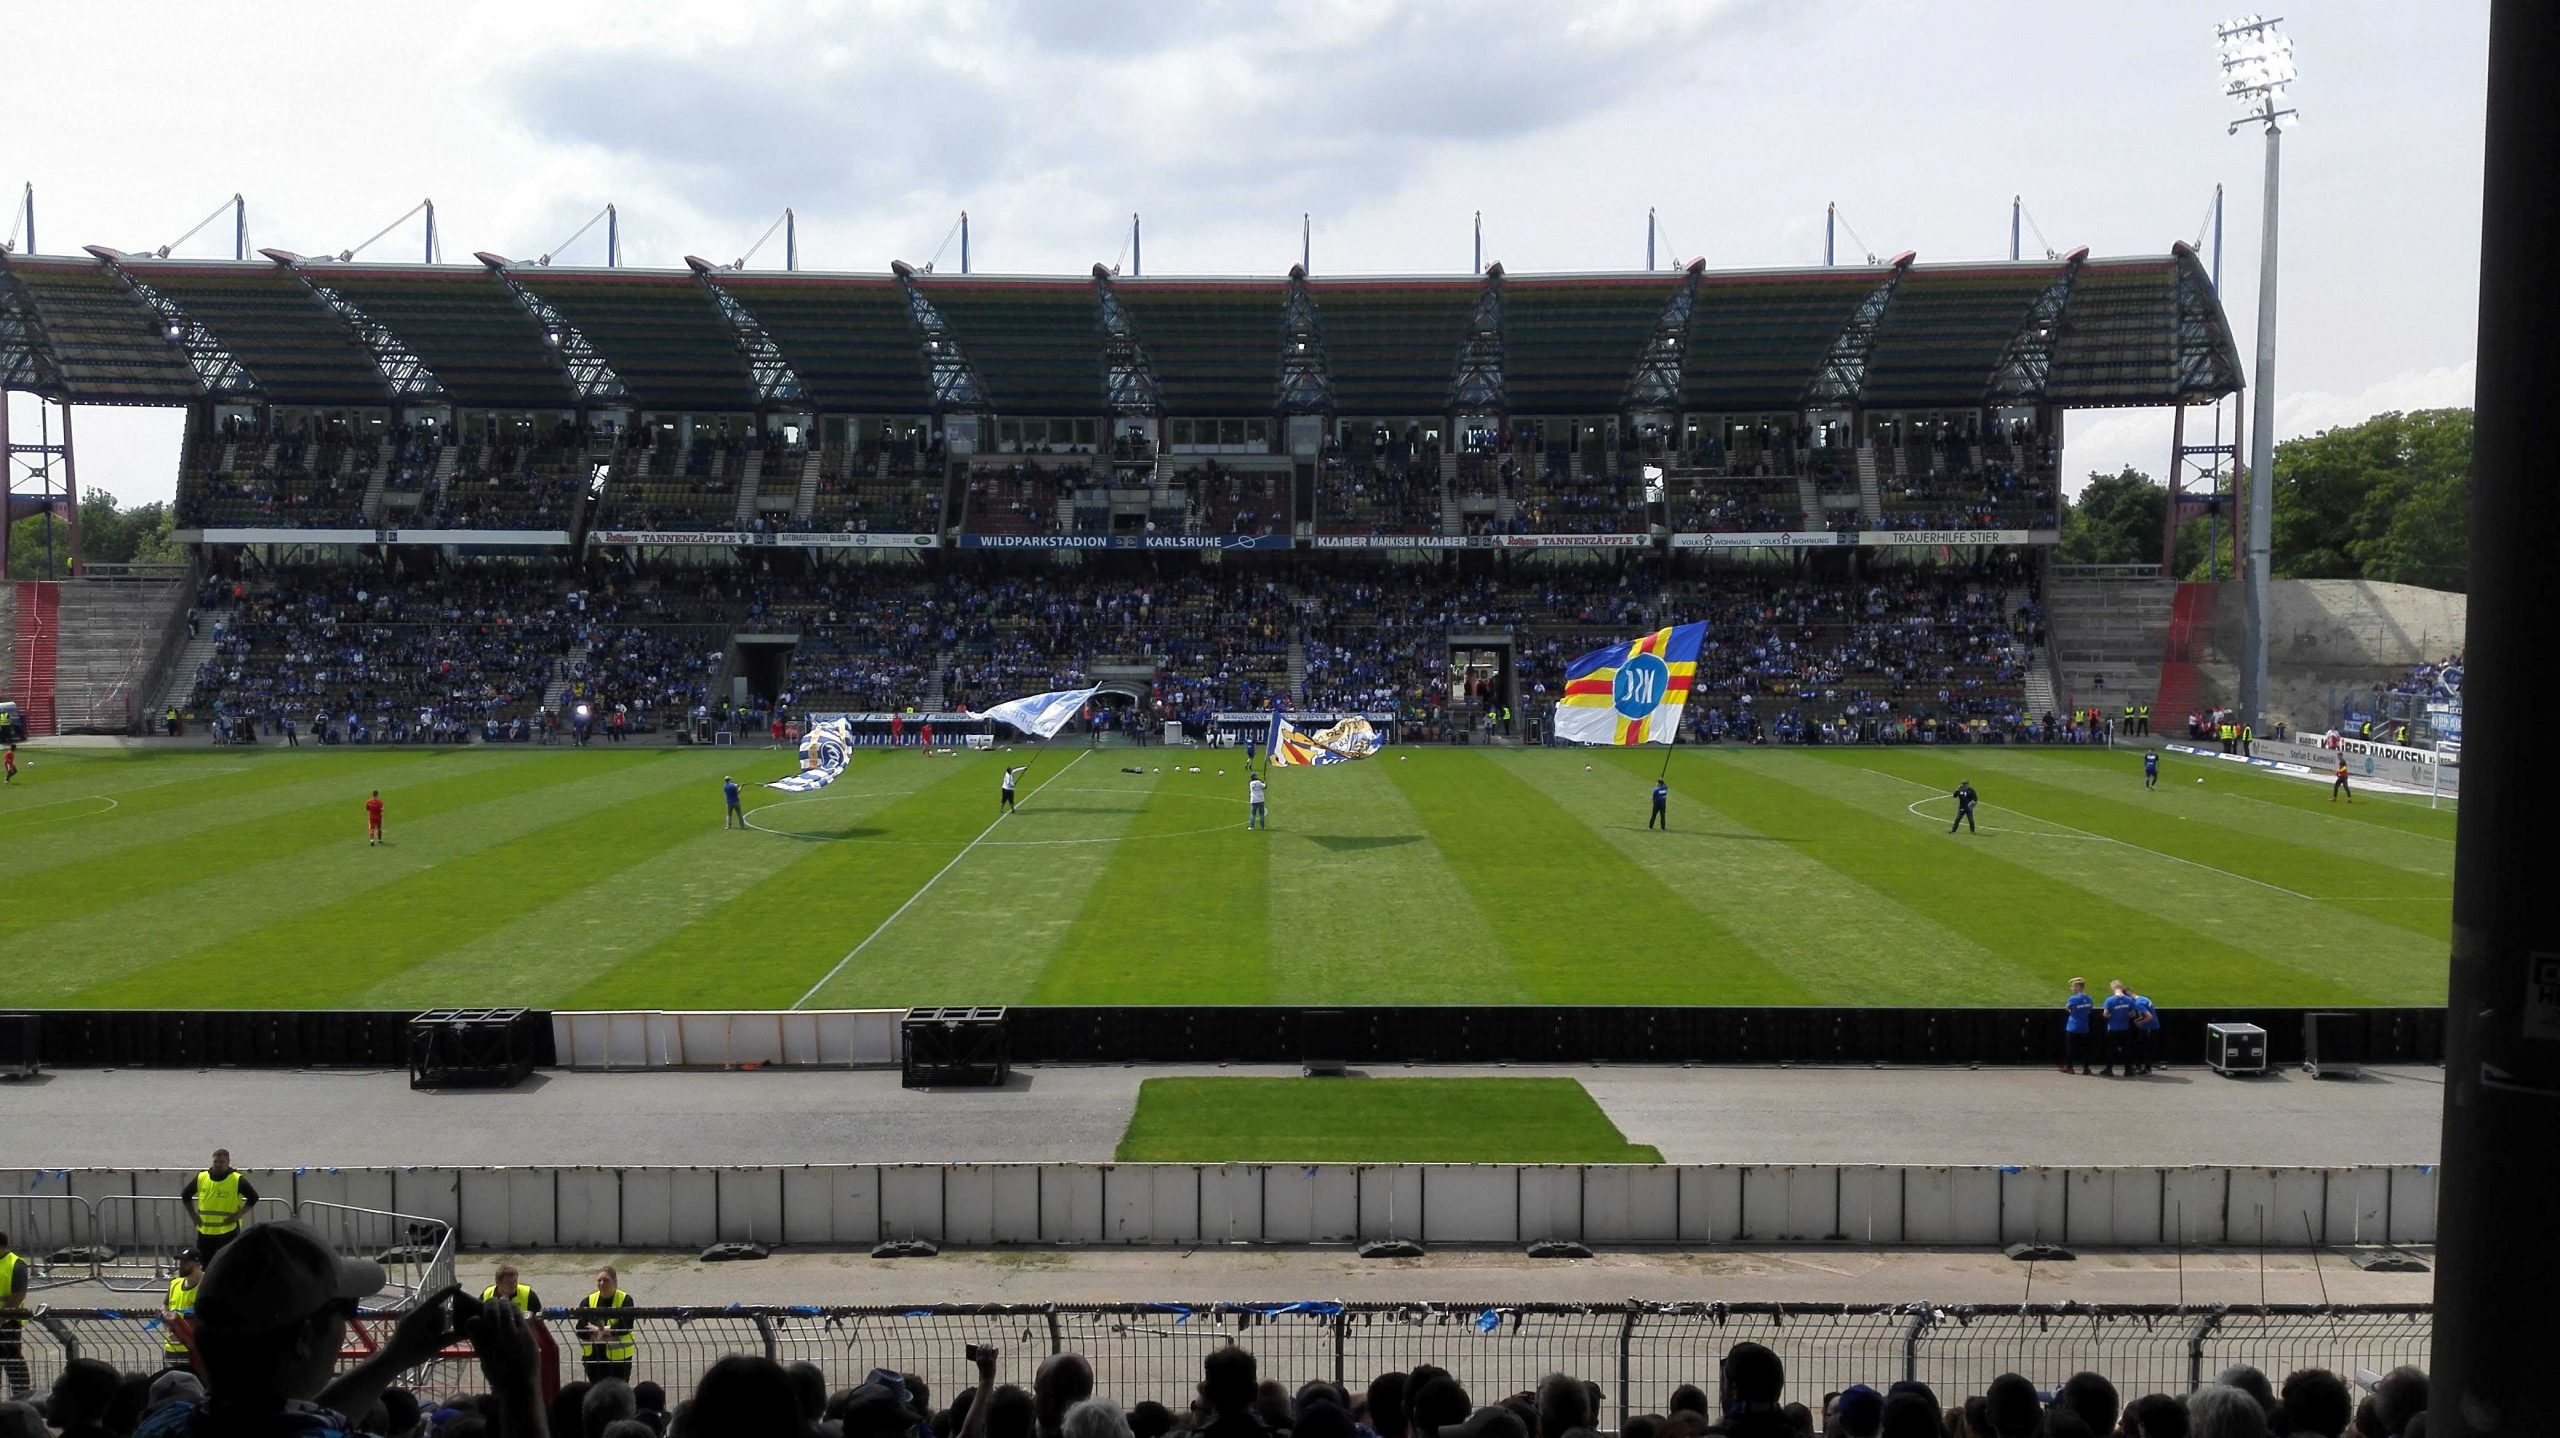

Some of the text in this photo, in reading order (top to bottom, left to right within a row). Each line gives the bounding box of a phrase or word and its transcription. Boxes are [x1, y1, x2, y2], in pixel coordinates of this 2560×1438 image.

[642, 532, 736, 543] TANNENZÄPFLE
[981, 536, 1107, 547] WILDPARKSTADION
[1146, 537, 1222, 547] KARLSRUHE
[1370, 536, 1415, 547] MARKISEN
[1542, 534, 1633, 545] TANNENZÄPFLE
[1893, 531, 1999, 543] TRAUERHILFE STIER
